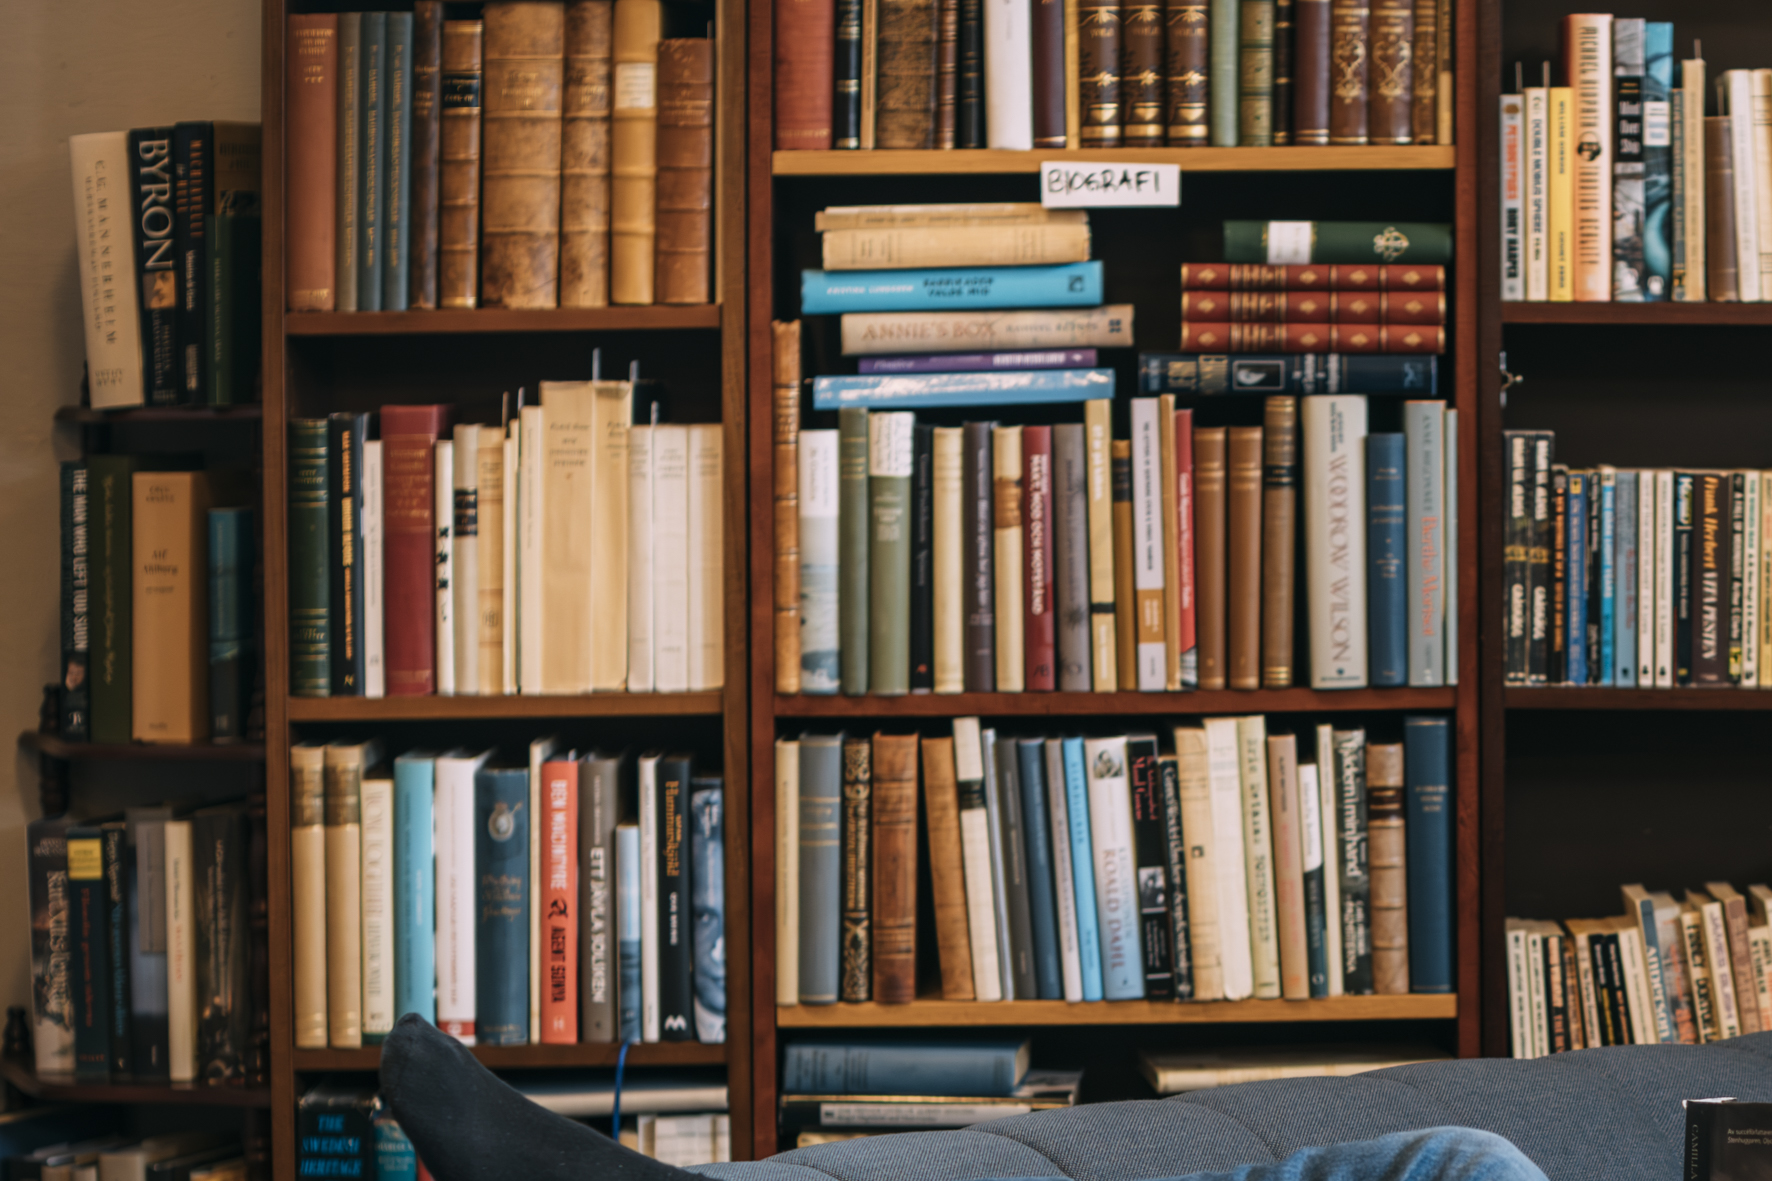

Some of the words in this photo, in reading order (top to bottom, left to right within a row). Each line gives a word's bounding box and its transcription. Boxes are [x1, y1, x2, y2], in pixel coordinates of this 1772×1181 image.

[139, 139, 174, 270] BYRON
[1046, 168, 1160, 196] BIOGRAFI
[862, 320, 950, 341] ANNIE'S
[953, 319, 997, 337] BOX
[73, 495, 88, 524] MAN
[1328, 454, 1351, 571] WOODROW
[1703, 476, 1719, 515] Frank
[73, 525, 88, 555] WHO
[1421, 516, 1438, 571] Berthe
[1703, 517, 1719, 570] Herbert
[73, 557, 88, 587] LEFT
[1329, 576, 1352, 661] WILSON
[1421, 574, 1438, 637] Morisot
[550, 779, 567, 809] BEN
[590, 847, 605, 880] ETT
[1103, 848, 1123, 913] ROALD
[589, 880, 608, 932] JÄVLA
[550, 925, 566, 962] AGENT
[1107, 920, 1126, 971] DAHL
[1709, 911, 1728, 969] JAMES
[1647, 945, 1670, 1038] Anderson
[302, 1136, 361, 1155] SWEDISH
[317, 1114, 345, 1133] THE
[300, 1158, 363, 1177] HERITAGE
[1690, 1123, 1699, 1181] CAMILLA
